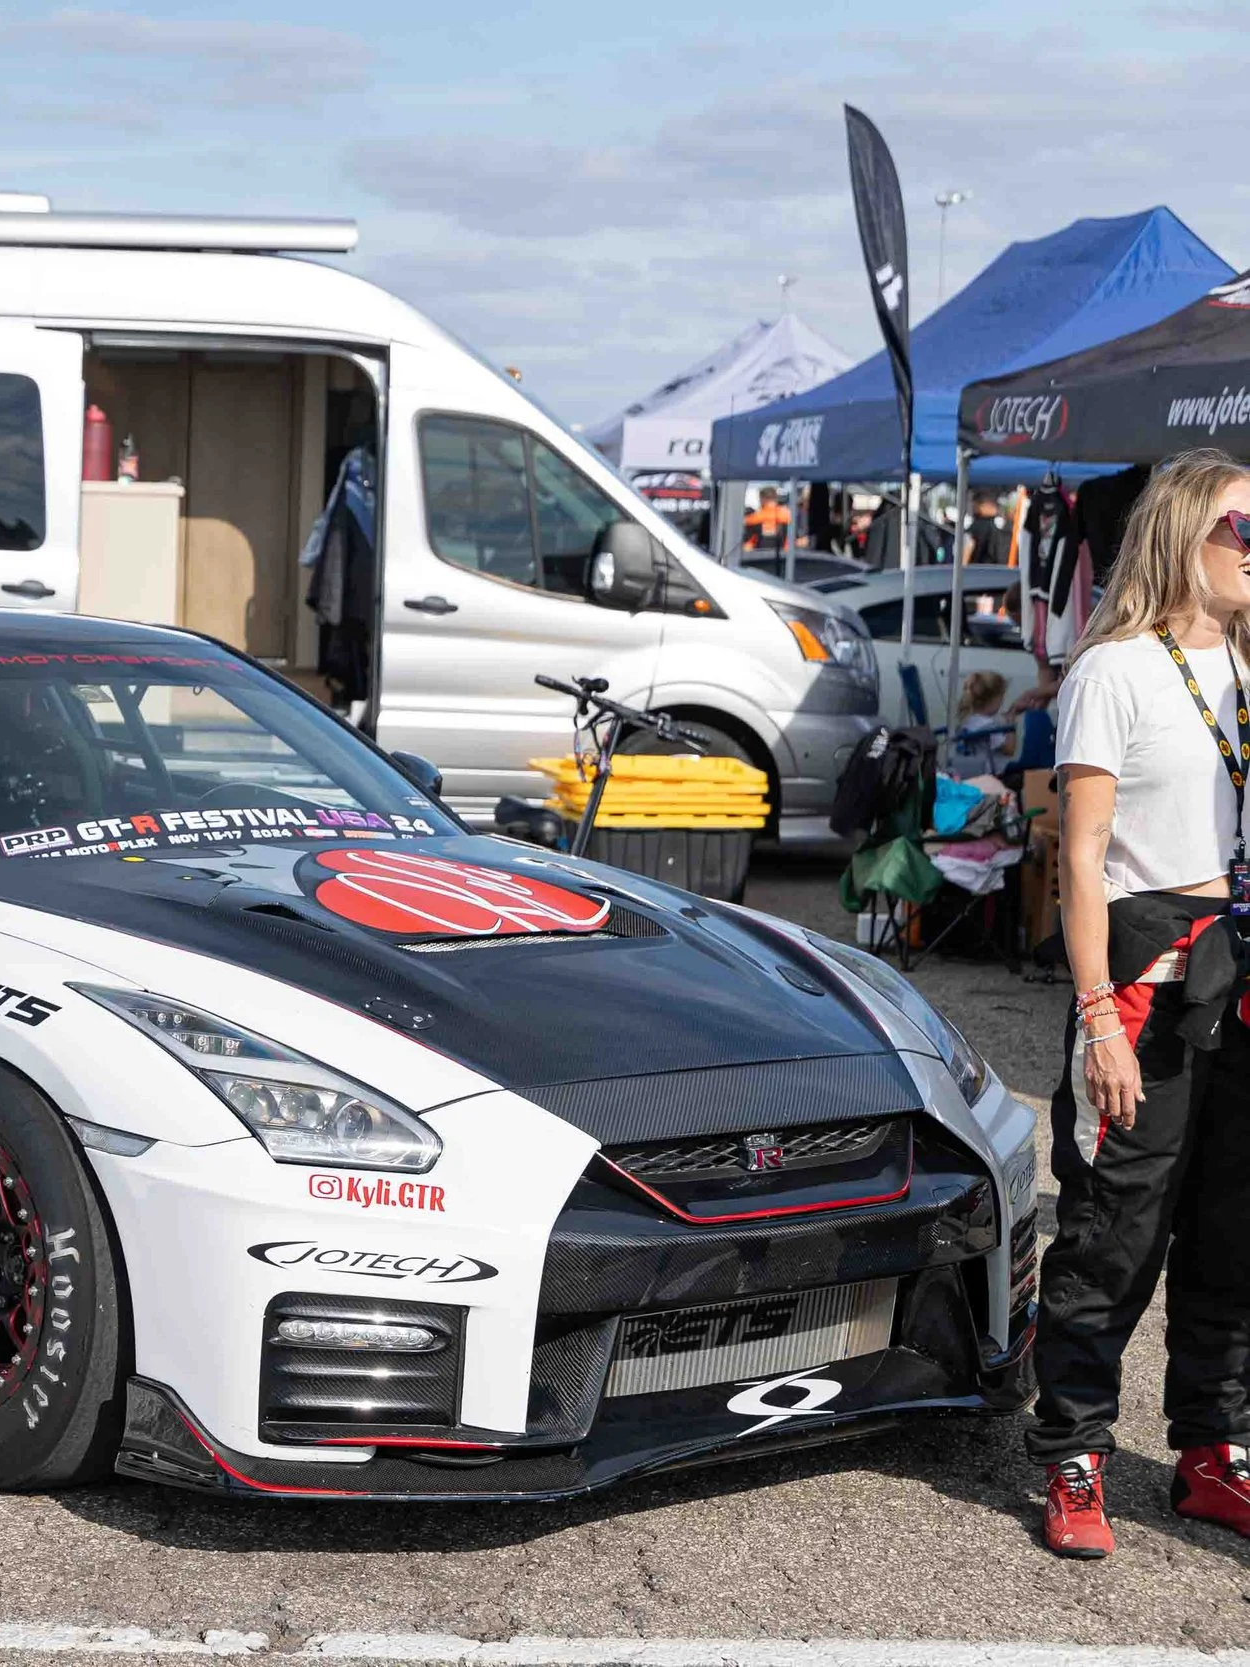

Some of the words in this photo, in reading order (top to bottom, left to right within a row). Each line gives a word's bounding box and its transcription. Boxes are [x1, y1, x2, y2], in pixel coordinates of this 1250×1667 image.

[990, 394, 1061, 441] JOTECH
[1167, 386, 1250, 436] www.jote
[4, 829, 67, 851] PRP
[76, 814, 161, 842] GT-R
[160, 808, 320, 832] FESTIVAL
[315, 808, 392, 830] USA
[390, 814, 436, 836] 24
[167, 832, 200, 845] NOV
[250, 828, 293, 839] 2024
[64, 837, 158, 858] MOTORPLEX
[346, 1177, 446, 1213] Kyli.GTR
[280, 1247, 464, 1279] JOTECH
